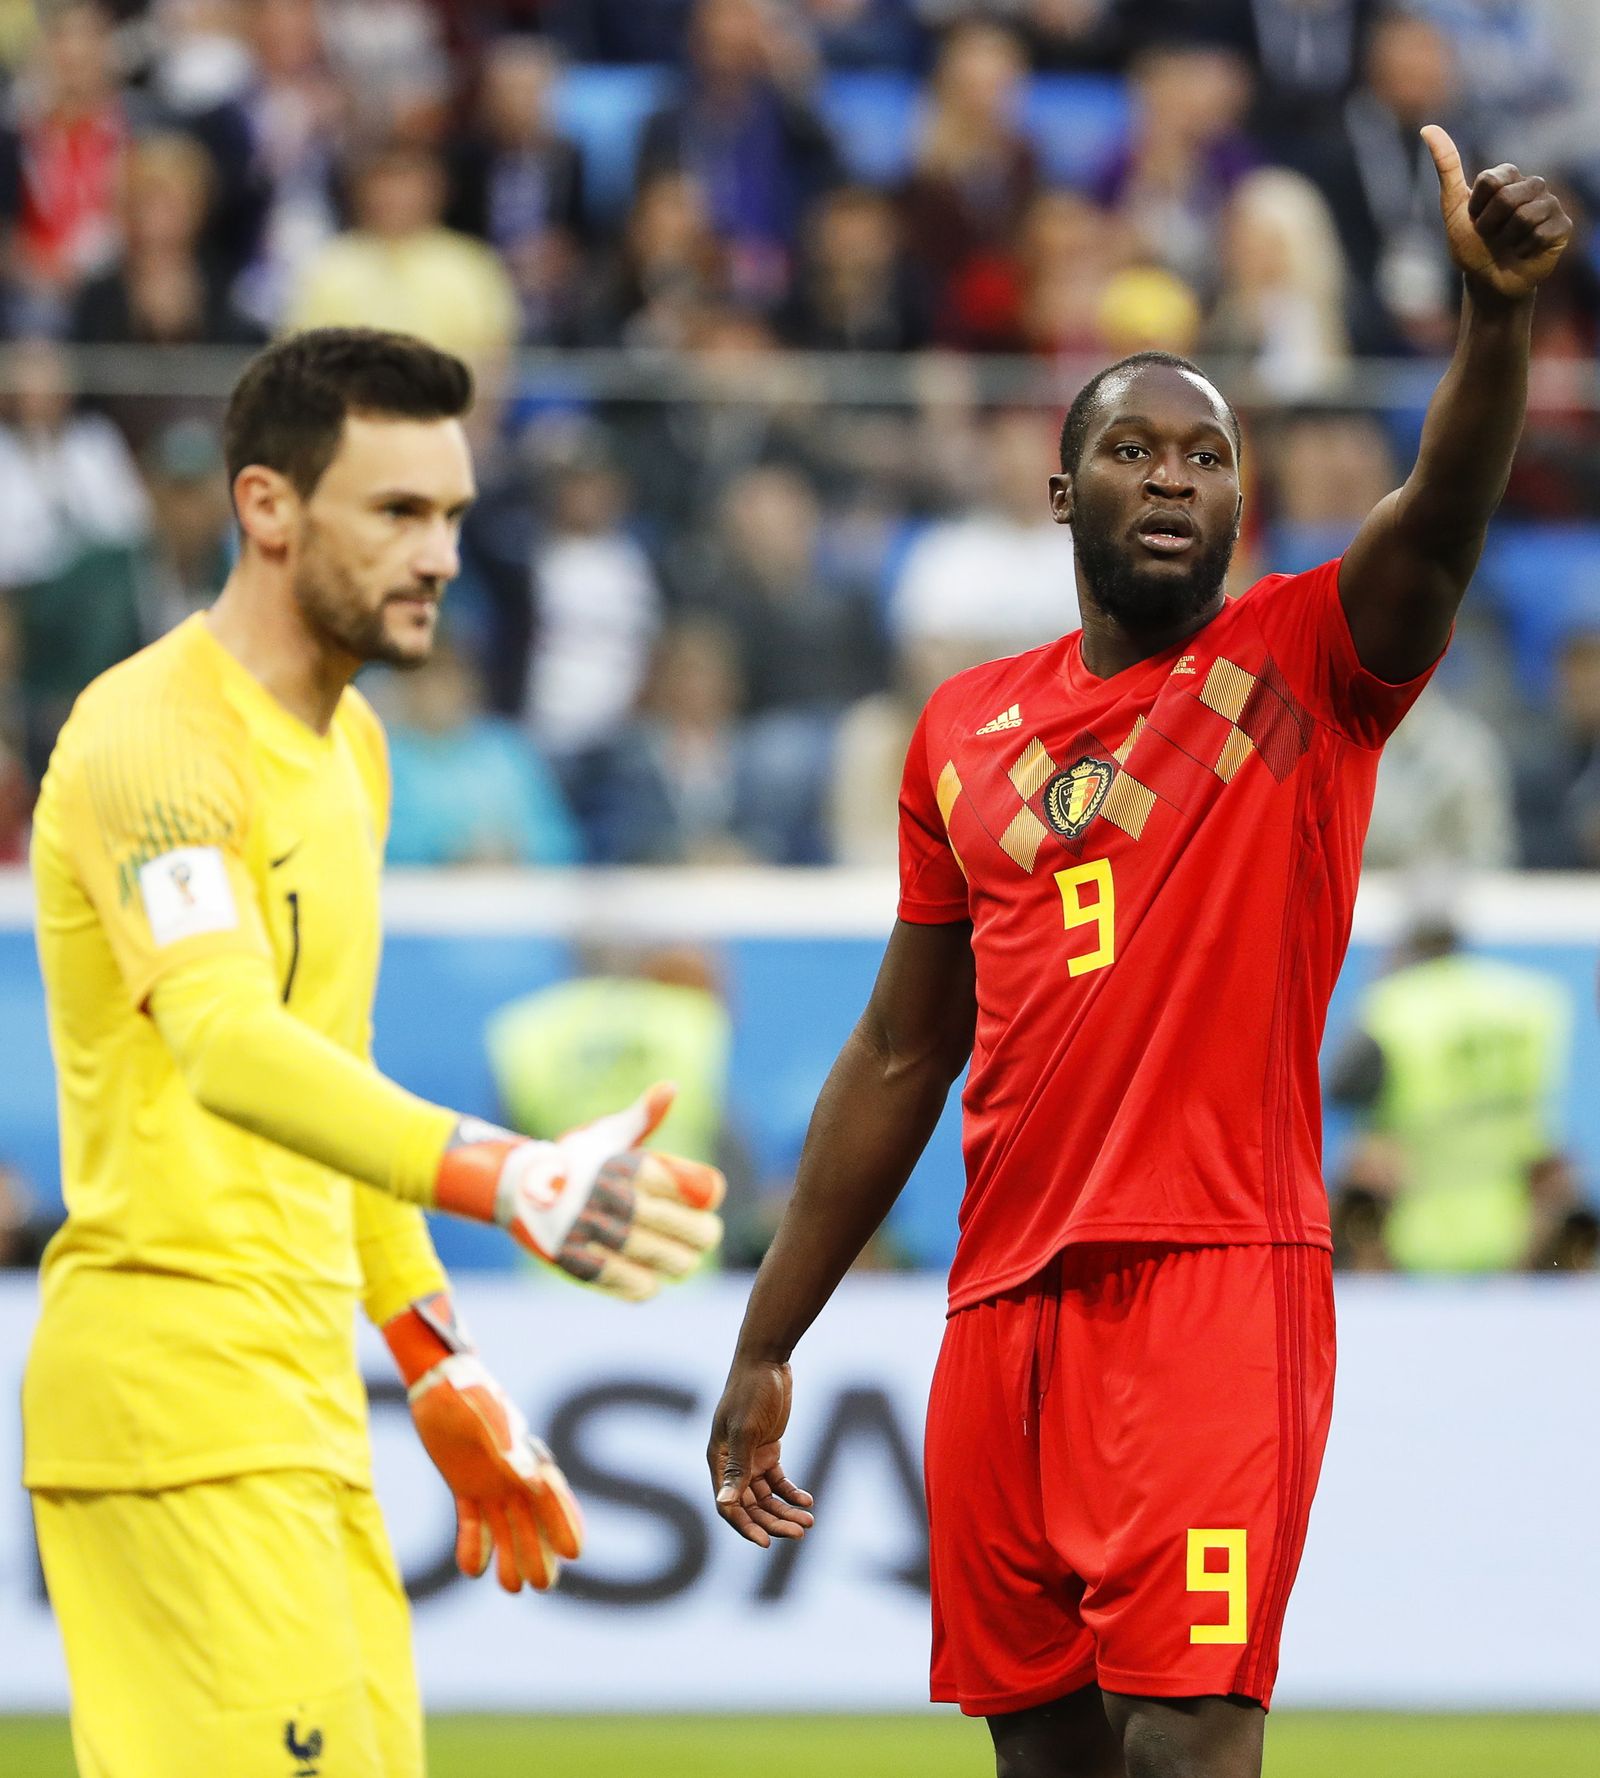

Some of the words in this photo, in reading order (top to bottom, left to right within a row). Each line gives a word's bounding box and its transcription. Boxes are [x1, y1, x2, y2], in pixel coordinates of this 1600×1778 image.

[975, 718, 1023, 736] adidas
[280, 891, 300, 1005] 1
[1053, 857, 1116, 978] 9
[1186, 1528, 1248, 1644] 9
